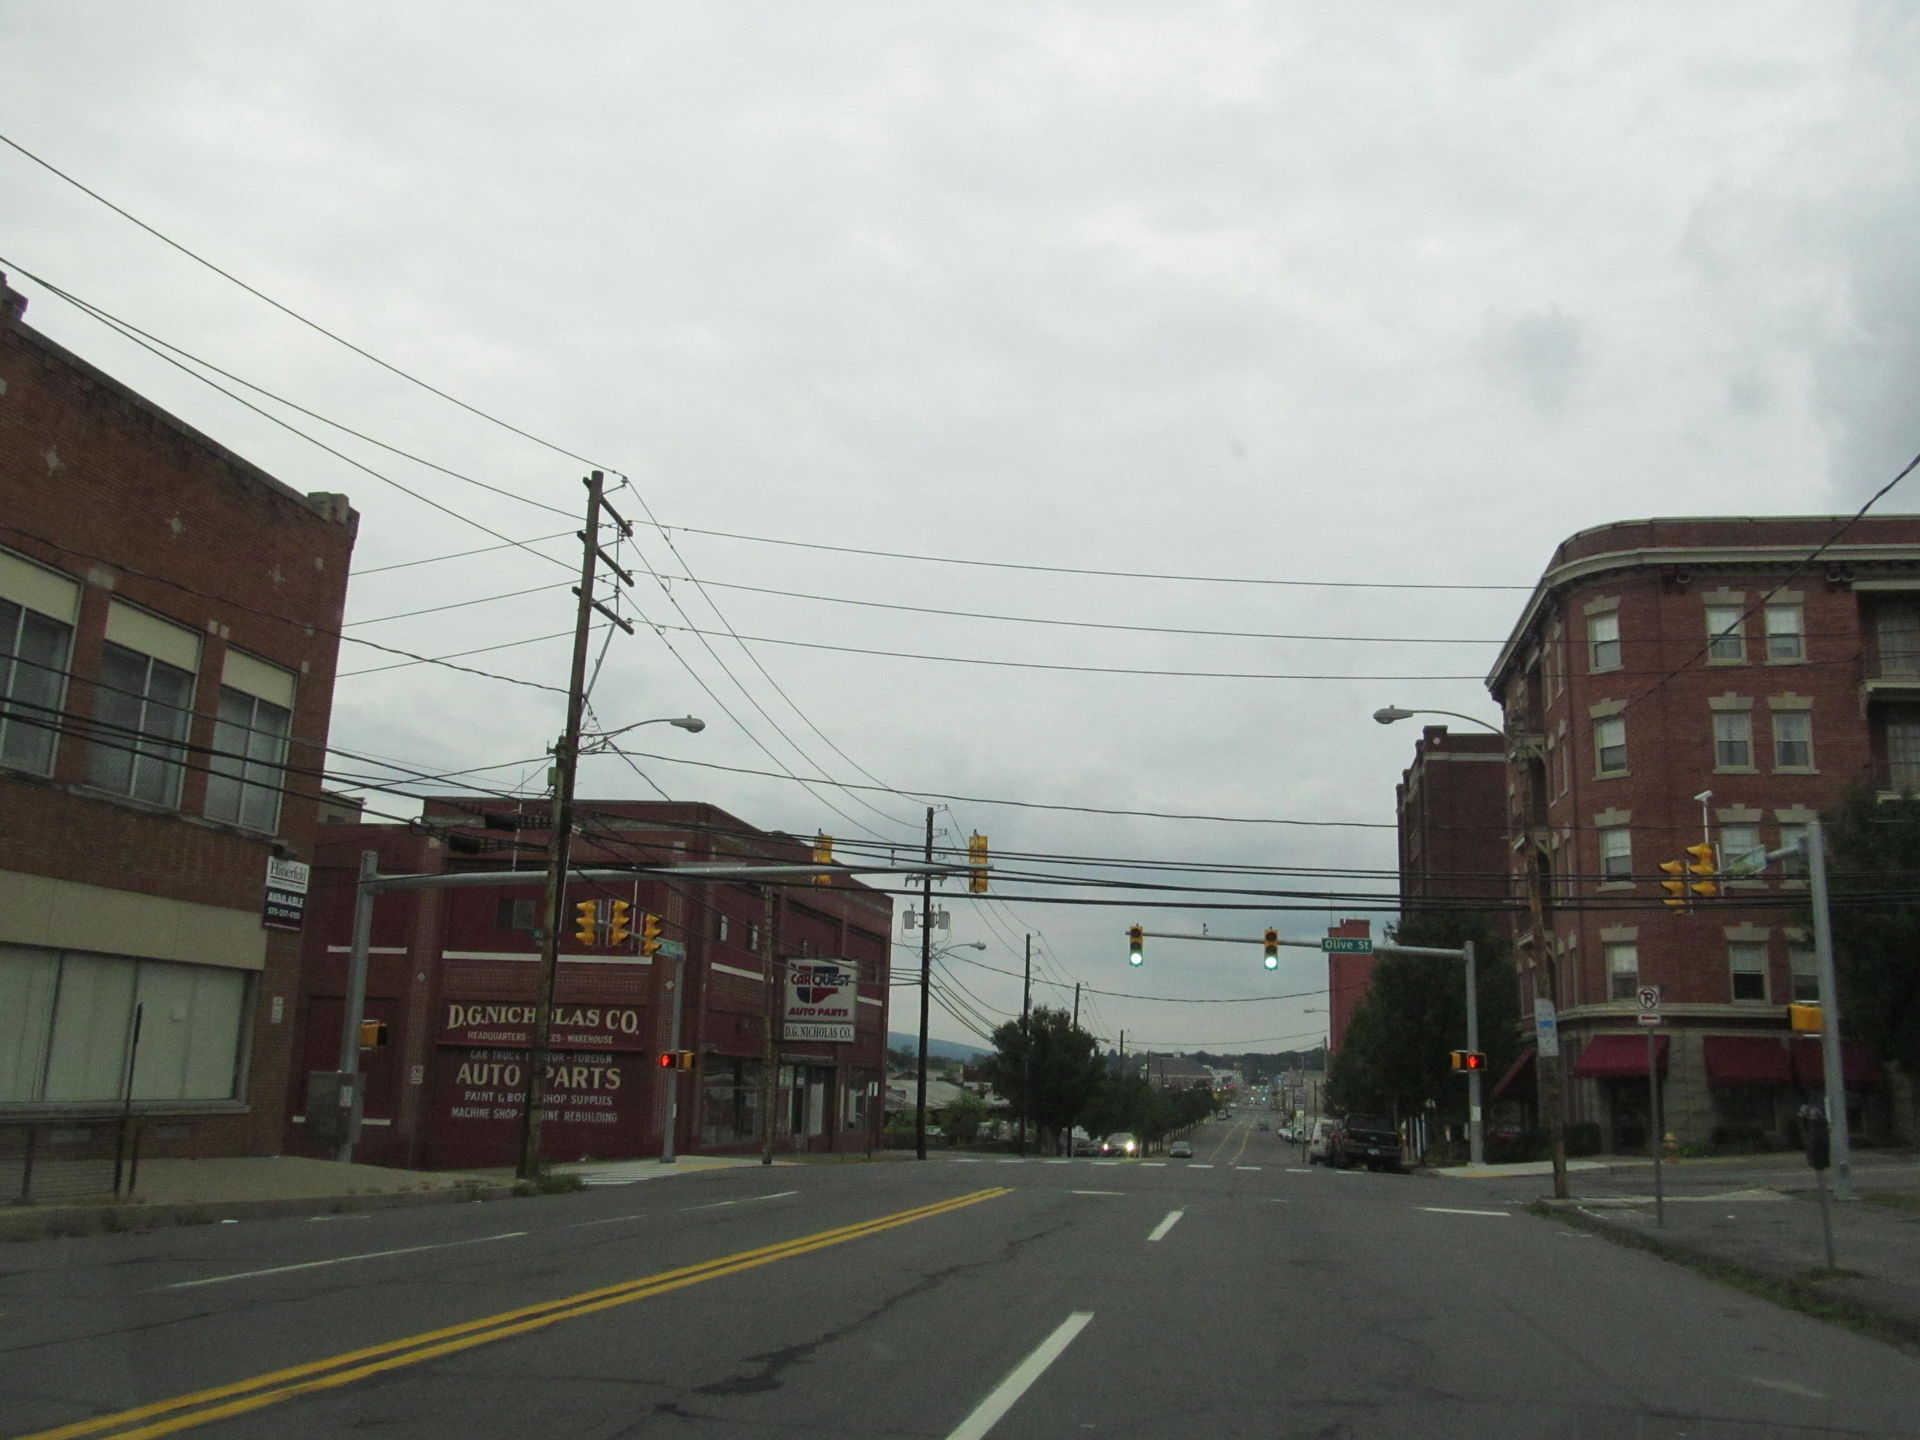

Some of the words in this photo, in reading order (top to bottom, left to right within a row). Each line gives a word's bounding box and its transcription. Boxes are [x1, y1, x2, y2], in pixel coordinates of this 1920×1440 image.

[267, 891, 304, 908] AVAILABLE
[1325, 940, 1353, 950] Olive
[1358, 940, 1369, 950] St
[788, 1007, 816, 1016] AUTO
[817, 1008, 849, 1017] PARTS
[605, 1009, 640, 1035] CO.
[567, 1034, 614, 1044] WAREHOUSE
[800, 1026, 838, 1038] NICHOLAS
[839, 1027, 852, 1039] CO.
[456, 1063, 521, 1086] AUTO
[464, 1091, 494, 1101] PAINT
[571, 1095, 613, 1106] SUPPLIES
[452, 1106, 489, 1118] MACHINE
[564, 1111, 618, 1123] REBUILDING
